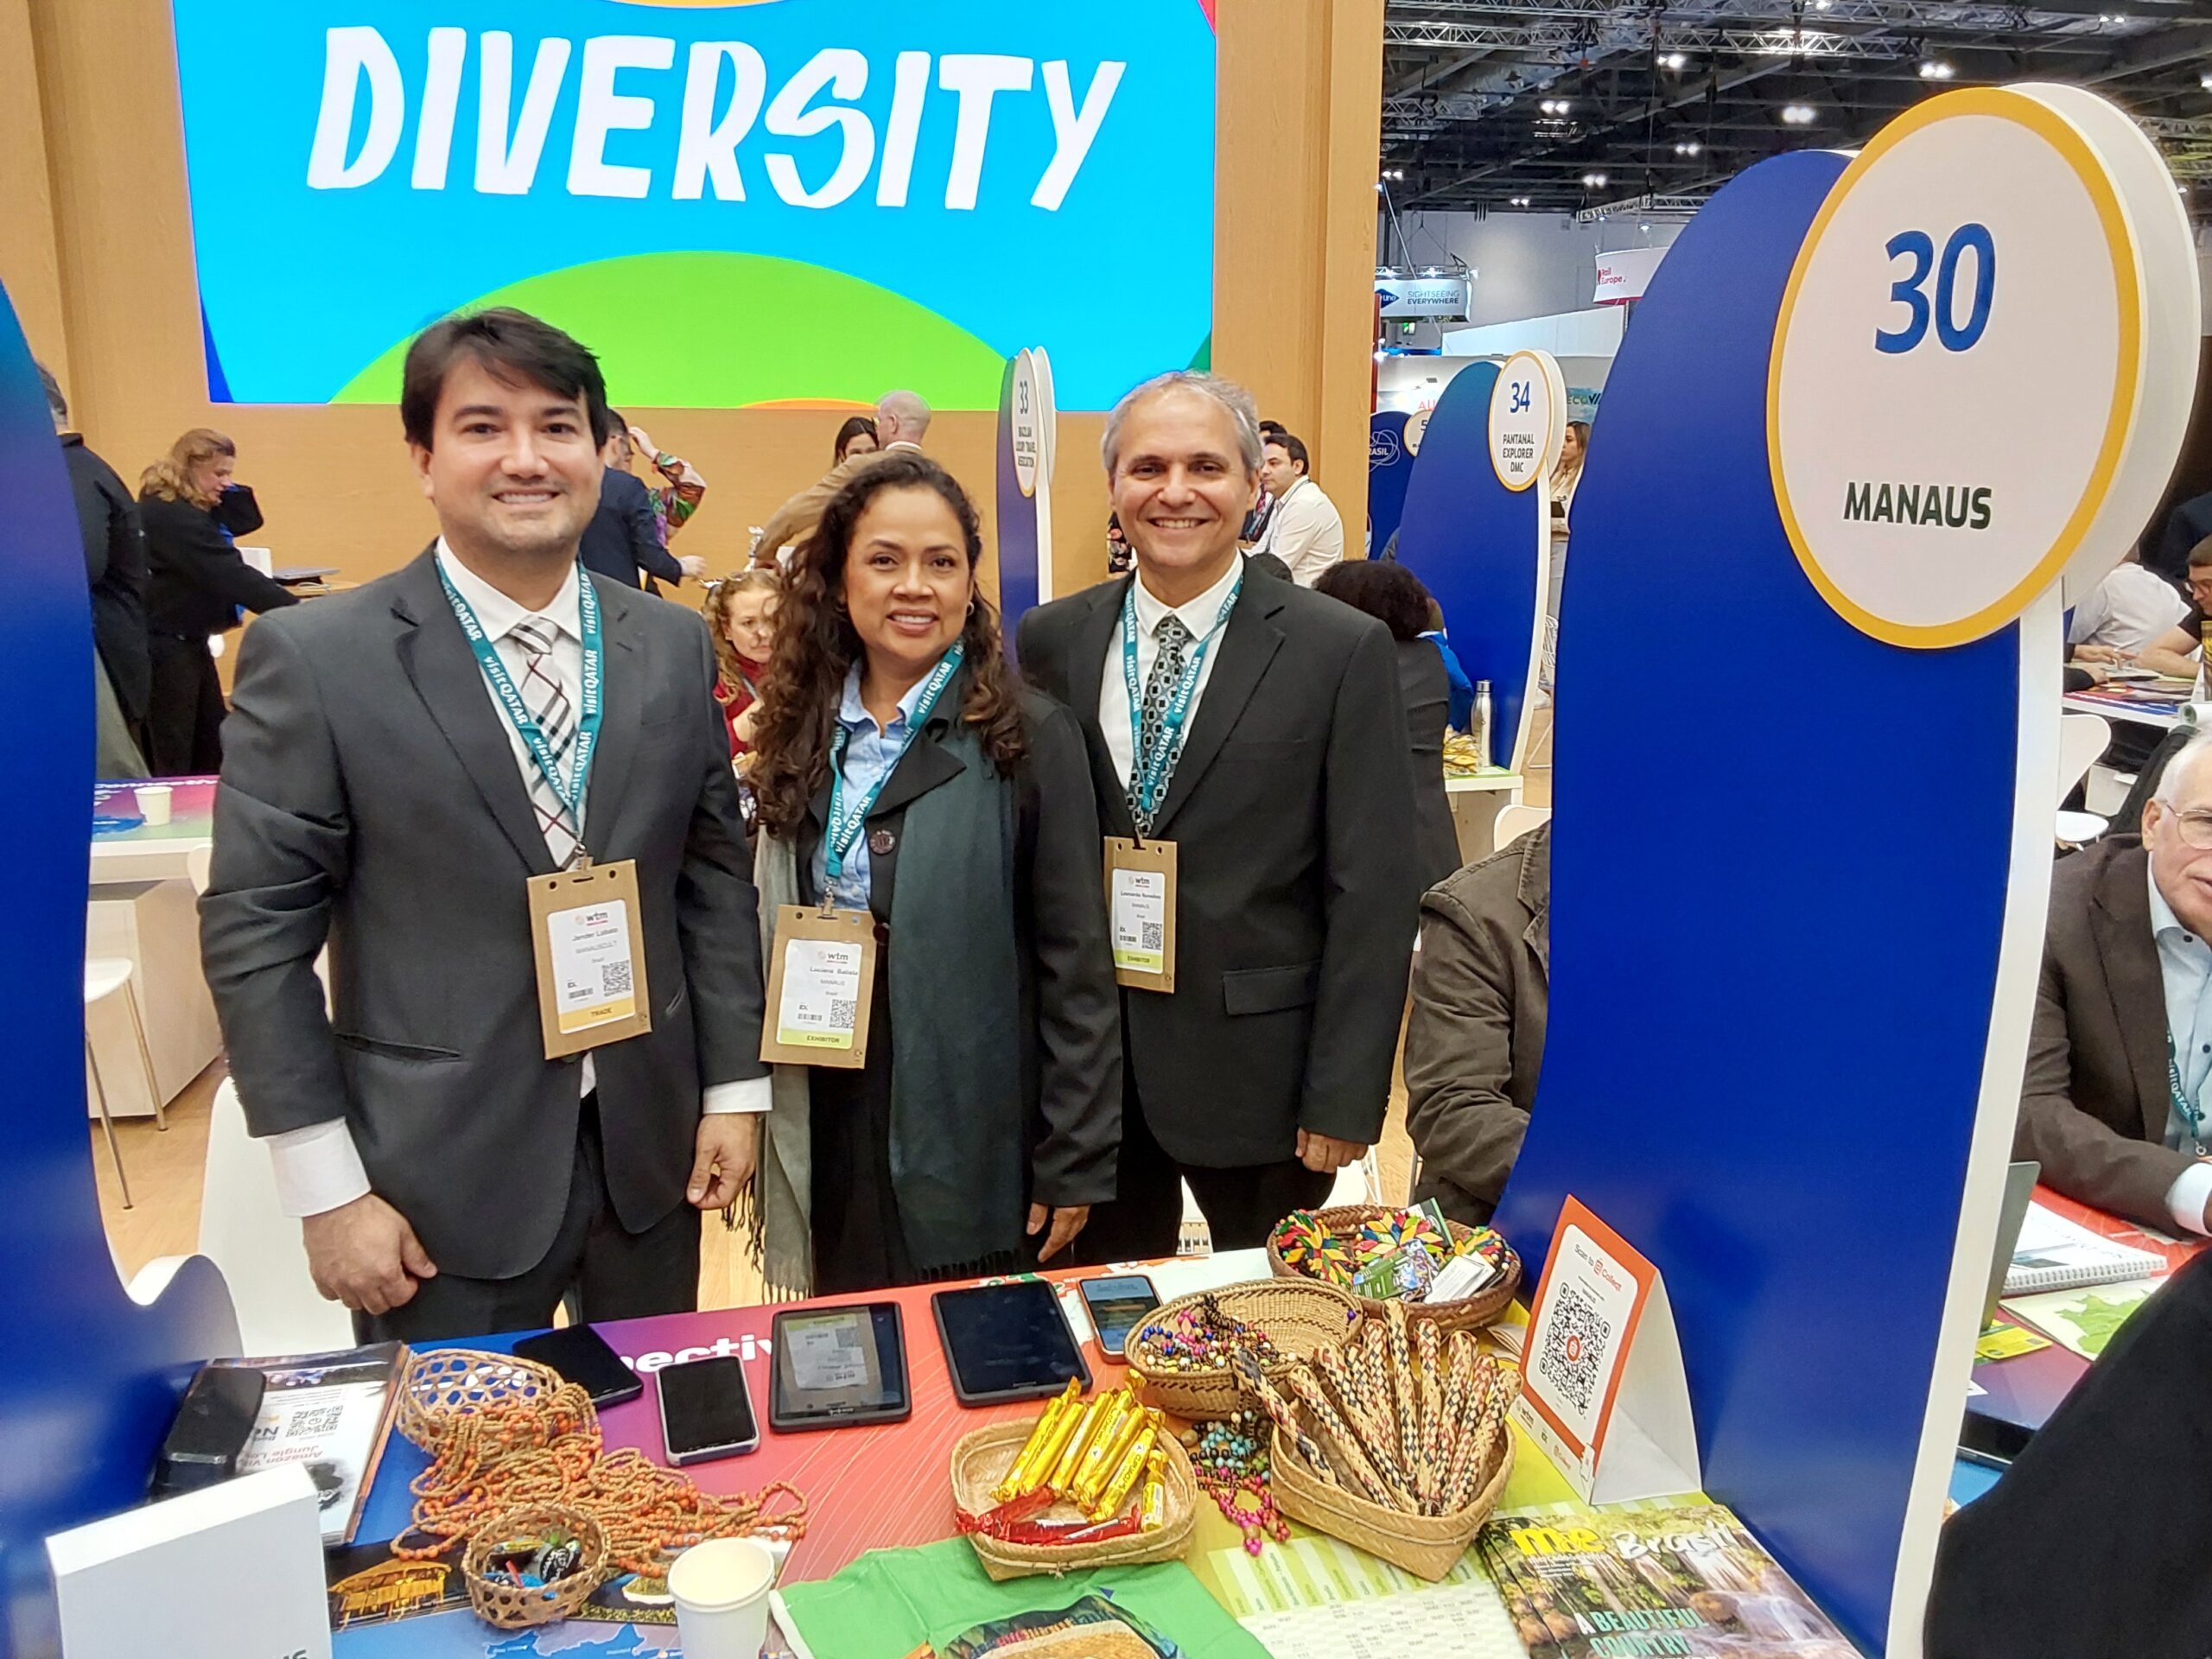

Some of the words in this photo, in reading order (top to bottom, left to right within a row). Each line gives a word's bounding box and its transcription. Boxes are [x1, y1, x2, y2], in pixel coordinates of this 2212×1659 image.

[306, 26, 1126, 211] DIVERSITY
[1408, 289, 1460, 298] SIGHTSEEING
[1874, 222, 1996, 354] 30
[1020, 380, 1029, 415] 33
[1510, 381, 1530, 413] 34
[1503, 434, 1535, 445] PANTANAL
[1503, 448, 1534, 459] EXPLORER
[1510, 461, 1524, 473] DMC
[1843, 481, 1993, 531] MANAUS
[587, 912, 608, 921] wtm
[806, 1034, 840, 1044] EXHIBITOR
[266, 1451, 324, 1464] Amazon
[271, 1445, 320, 1457] Jungle
[1610, 1519, 1740, 1560] Brasil
[1573, 1612, 1597, 1635] A
[1589, 1608, 1709, 1632] BEAUTIFUL
[1589, 1635, 1692, 1658] COUNTRY
